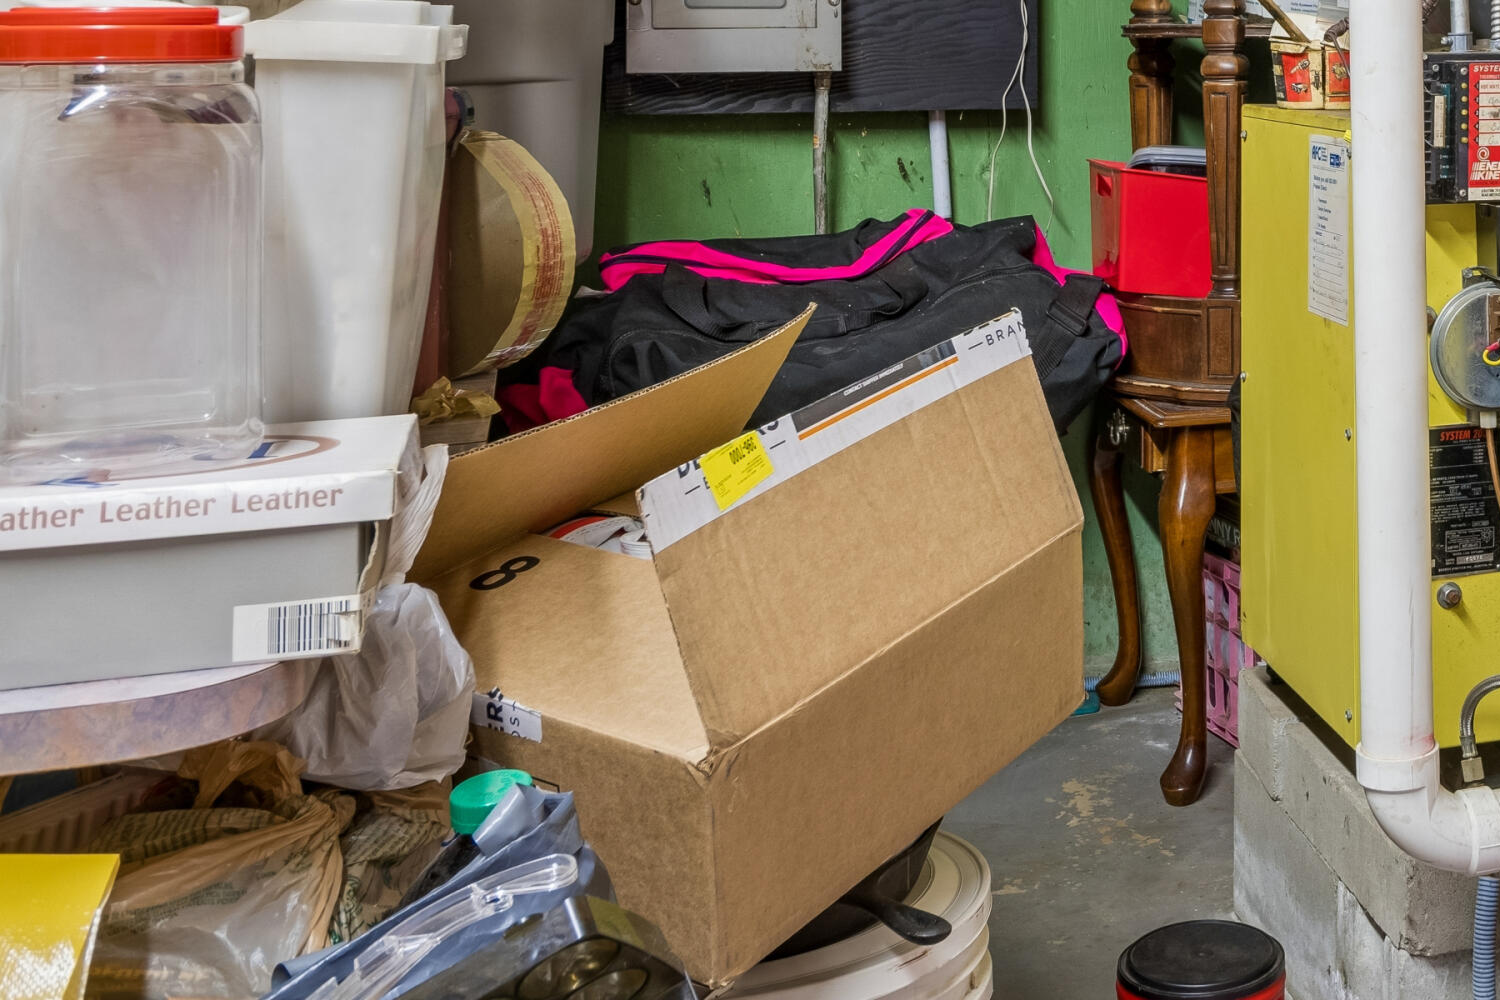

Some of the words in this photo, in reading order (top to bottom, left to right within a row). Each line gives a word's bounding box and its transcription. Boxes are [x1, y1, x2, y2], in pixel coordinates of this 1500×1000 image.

[1440, 430, 1471, 441] SYSTEM
[99, 494, 217, 525] Leather
[230, 485, 344, 515] Leather
